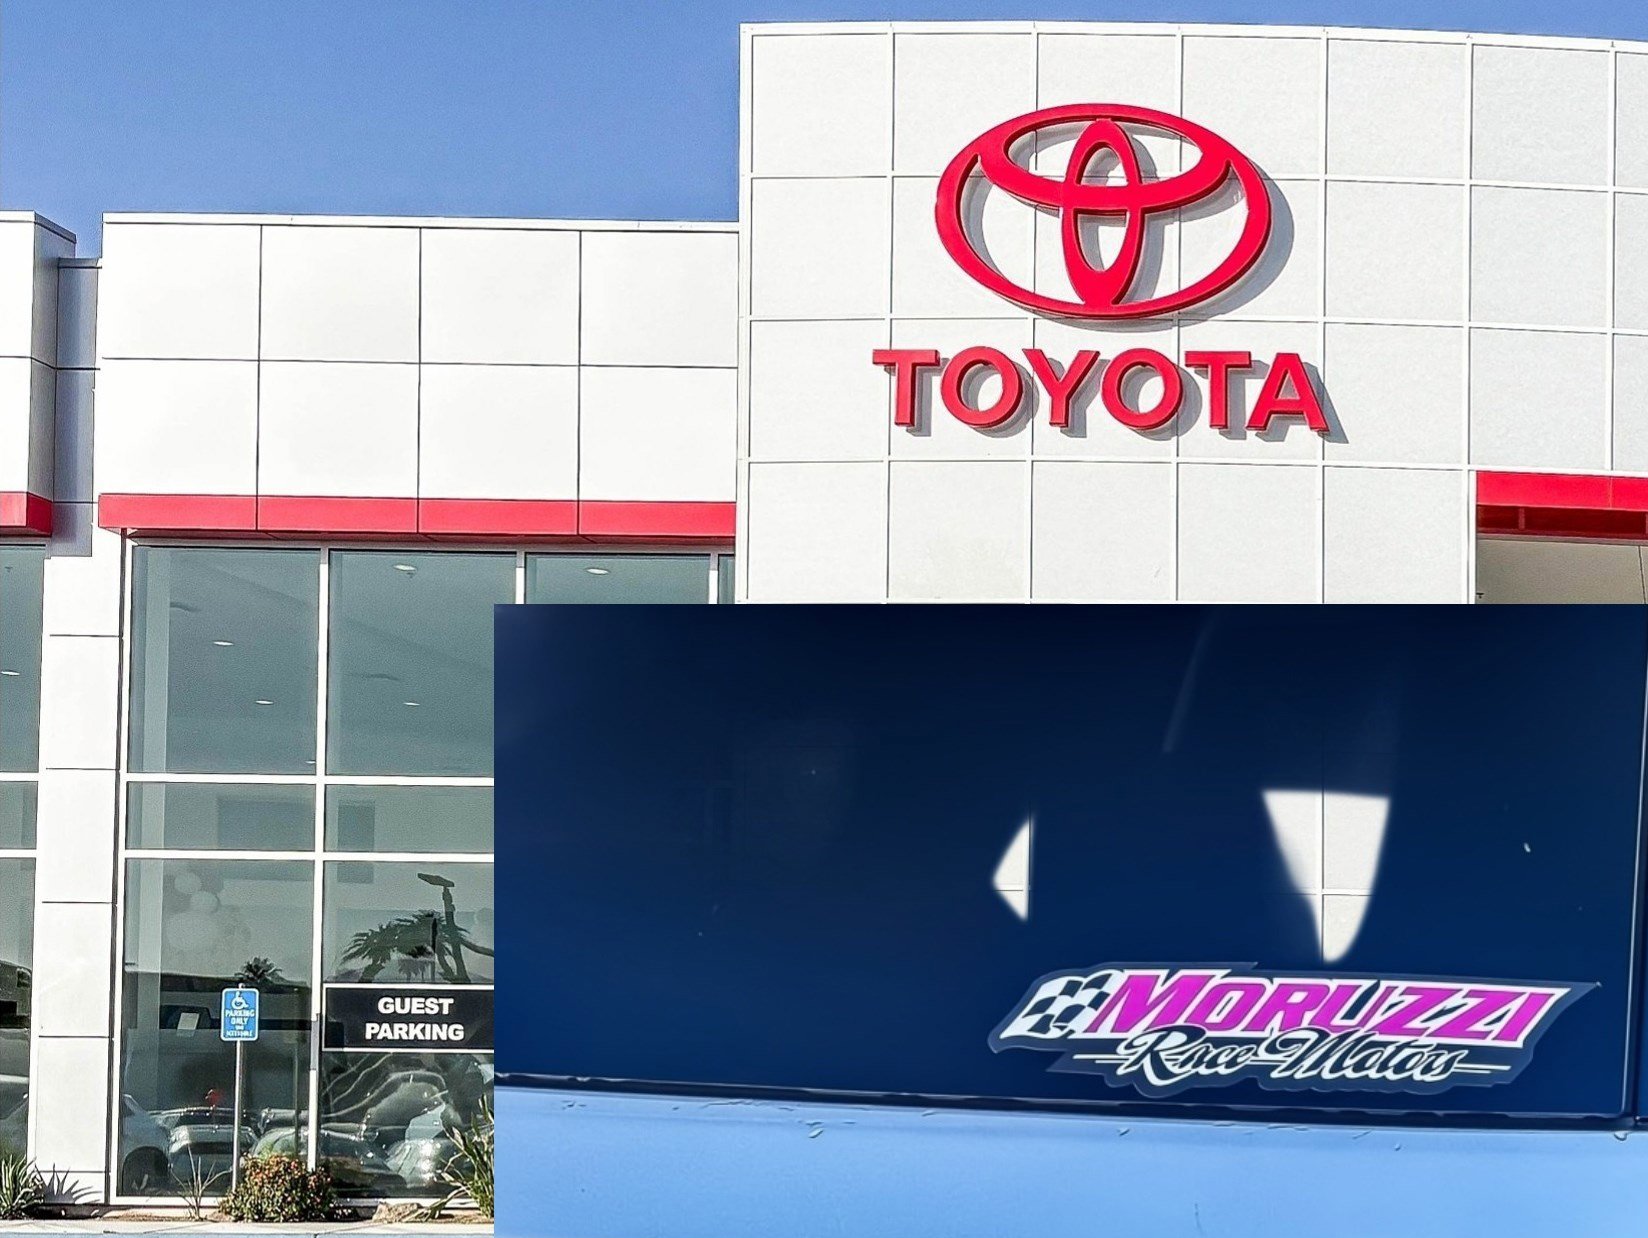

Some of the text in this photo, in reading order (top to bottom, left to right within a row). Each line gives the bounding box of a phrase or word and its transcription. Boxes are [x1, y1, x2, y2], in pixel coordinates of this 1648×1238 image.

[872, 346, 1329, 432] TOYOTA
[378, 997, 454, 1015] GUEST
[1083, 974, 1556, 1042] MORUZZI
[366, 1023, 465, 1041] PARKING
